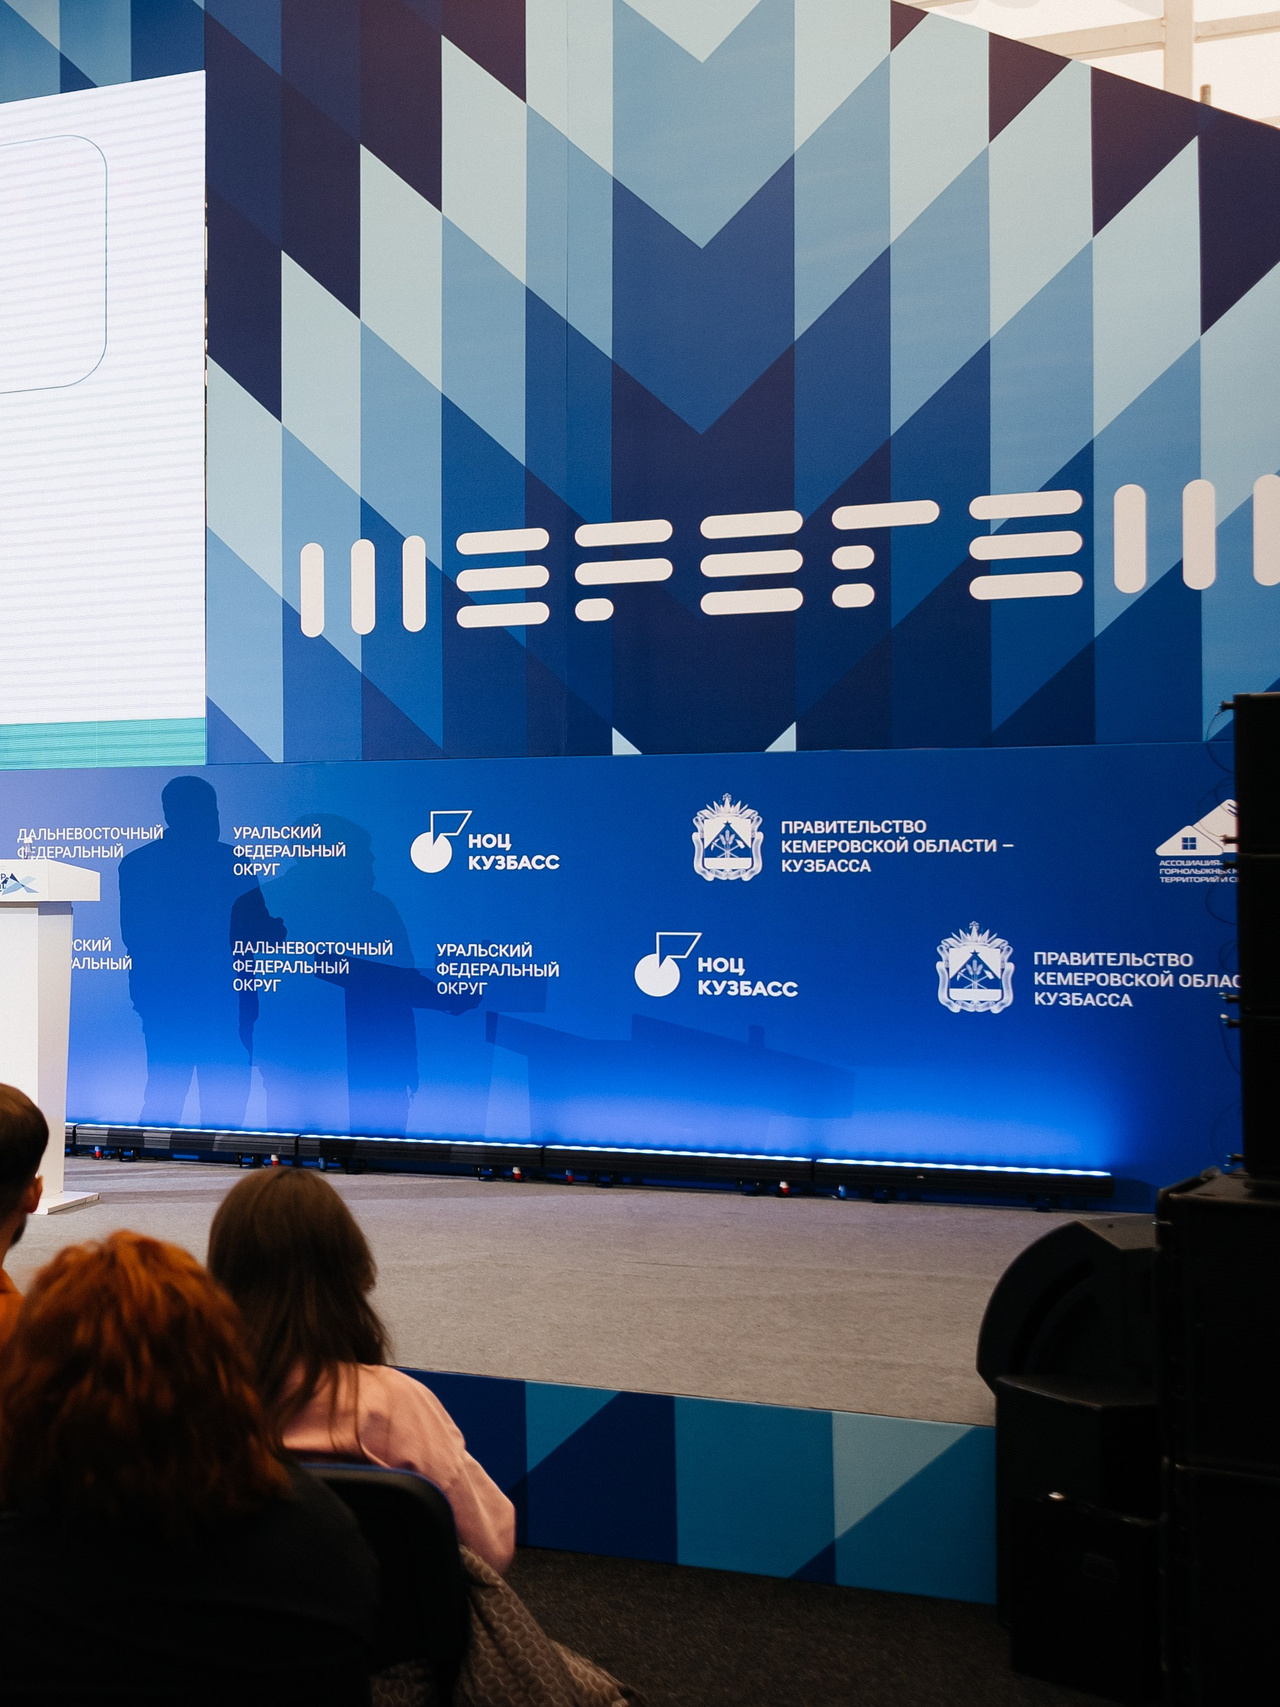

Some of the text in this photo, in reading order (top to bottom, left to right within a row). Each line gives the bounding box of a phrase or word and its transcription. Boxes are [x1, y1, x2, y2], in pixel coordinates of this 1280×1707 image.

[16, 824, 164, 843] ДАЛЬНЕВОСТОЧНЫЙ
[233, 823, 322, 839] УРАЛЬСКИЙ
[780, 819, 927, 834] ПРАВИТЕЛЬСТВО
[233, 841, 347, 860] ФЕДЕРАЛЬНЫЙ
[468, 833, 512, 851] НОЦ
[781, 836, 909, 854] КЕМЕРОВСКОЙ
[913, 838, 998, 853] ОБЛАСТИ
[233, 862, 280, 876] ОКРУГ
[468, 854, 561, 871] КУЗБАСС
[781, 859, 872, 873] КУЗБАССА
[232, 939, 394, 956] ДАЛЬНЕВОСТОЧНЫЙ
[436, 941, 533, 958] УРАЛЬСКИЙ
[232, 958, 350, 975] ФЕДЕРАЛЬНЫЙ
[697, 957, 746, 976] НОЦ
[1033, 951, 1194, 967] ПРАВИТЕЛЬСТВО
[436, 961, 560, 979] ФЕДЕРАЛЬНЫЙ
[1034, 969, 1174, 988] КЕМЕРОВСКОЙ
[232, 978, 282, 993] ОКРУГ
[436, 981, 488, 996] ОКРУГ
[697, 980, 799, 997] КУЗБАСС
[1034, 992, 1133, 1007] КУЗБАССА
